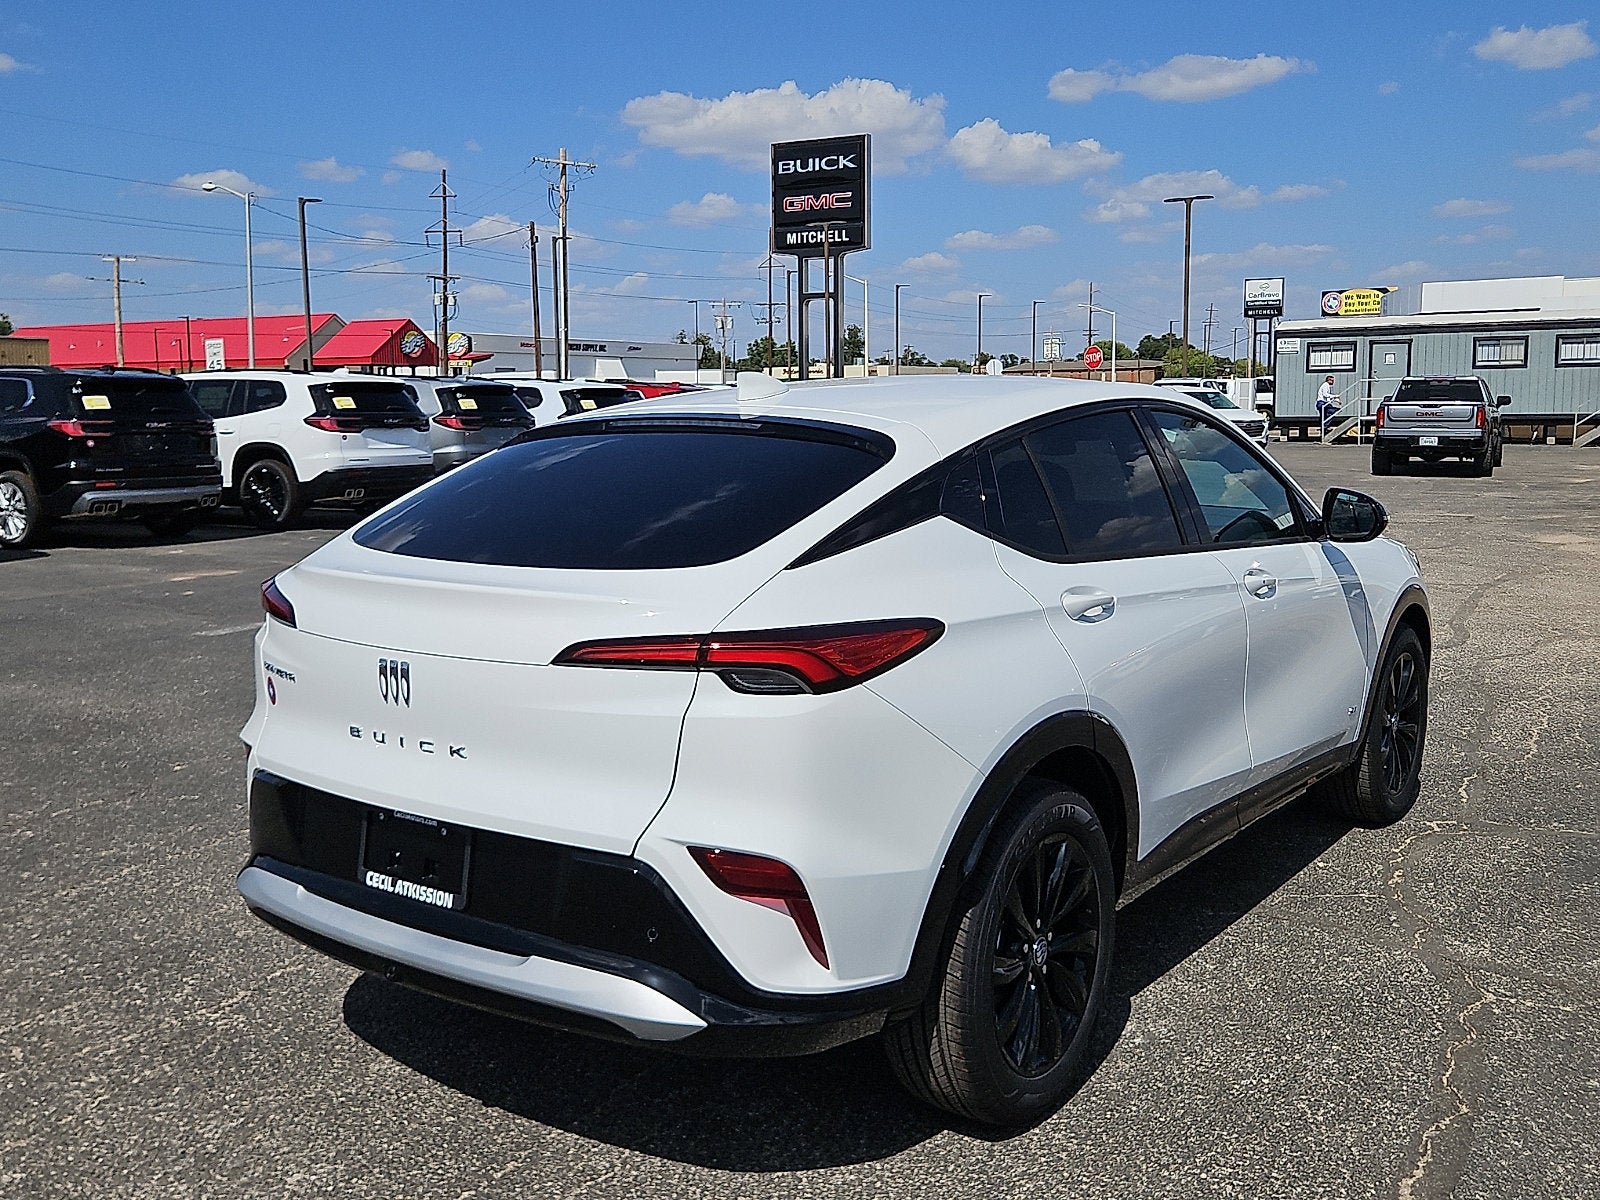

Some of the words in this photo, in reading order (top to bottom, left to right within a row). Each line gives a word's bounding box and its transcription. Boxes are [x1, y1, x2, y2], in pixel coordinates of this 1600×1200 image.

[778, 153, 858, 175] BUICK
[783, 191, 853, 213] GMC
[786, 229, 850, 245] MITCHELL
[208, 360, 223, 369] 45
[1085, 352, 1101, 364] STOP
[349, 725, 468, 760] BUICK
[365, 870, 394, 893] CECIL
[394, 879, 454, 909] ATKISSION
